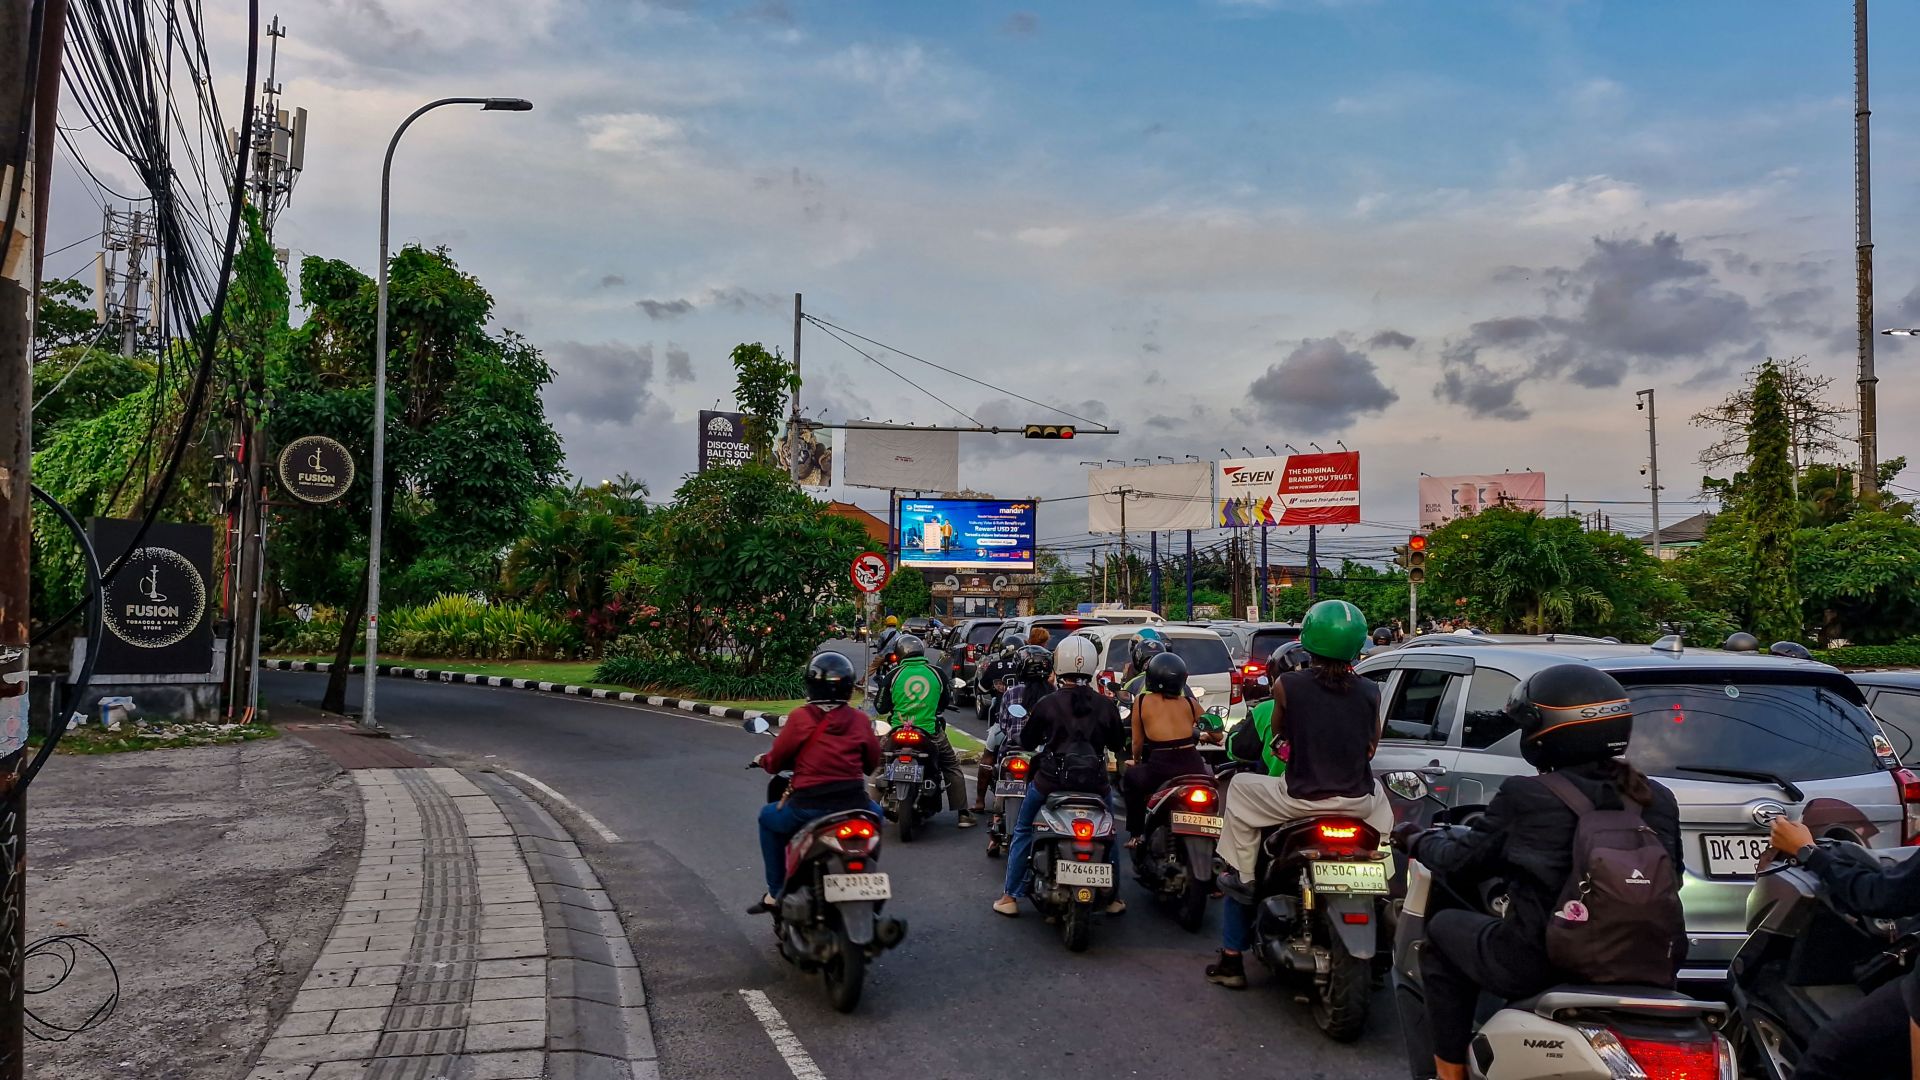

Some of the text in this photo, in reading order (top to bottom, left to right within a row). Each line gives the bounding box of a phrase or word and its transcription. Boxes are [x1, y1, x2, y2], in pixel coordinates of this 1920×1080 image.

[706, 440, 750, 451] DISCOVER
[706, 449, 754, 459] BALI'S SOU
[1302, 466, 1335, 474] ORIGINAL
[298, 472, 336, 483] FUSION
[1231, 470, 1274, 483] SEVEN
[126, 604, 179, 618] FUSION
[1174, 814, 1179, 822] B
[1182, 815, 1202, 824] 6227
[1709, 839, 1734, 860] DK
[1060, 862, 1110, 875] DK 2646 FBT
[1315, 864, 1329, 876] DK
[1353, 881, 1383, 889] 01-30
[1523, 1038, 1565, 1049] NMAX
